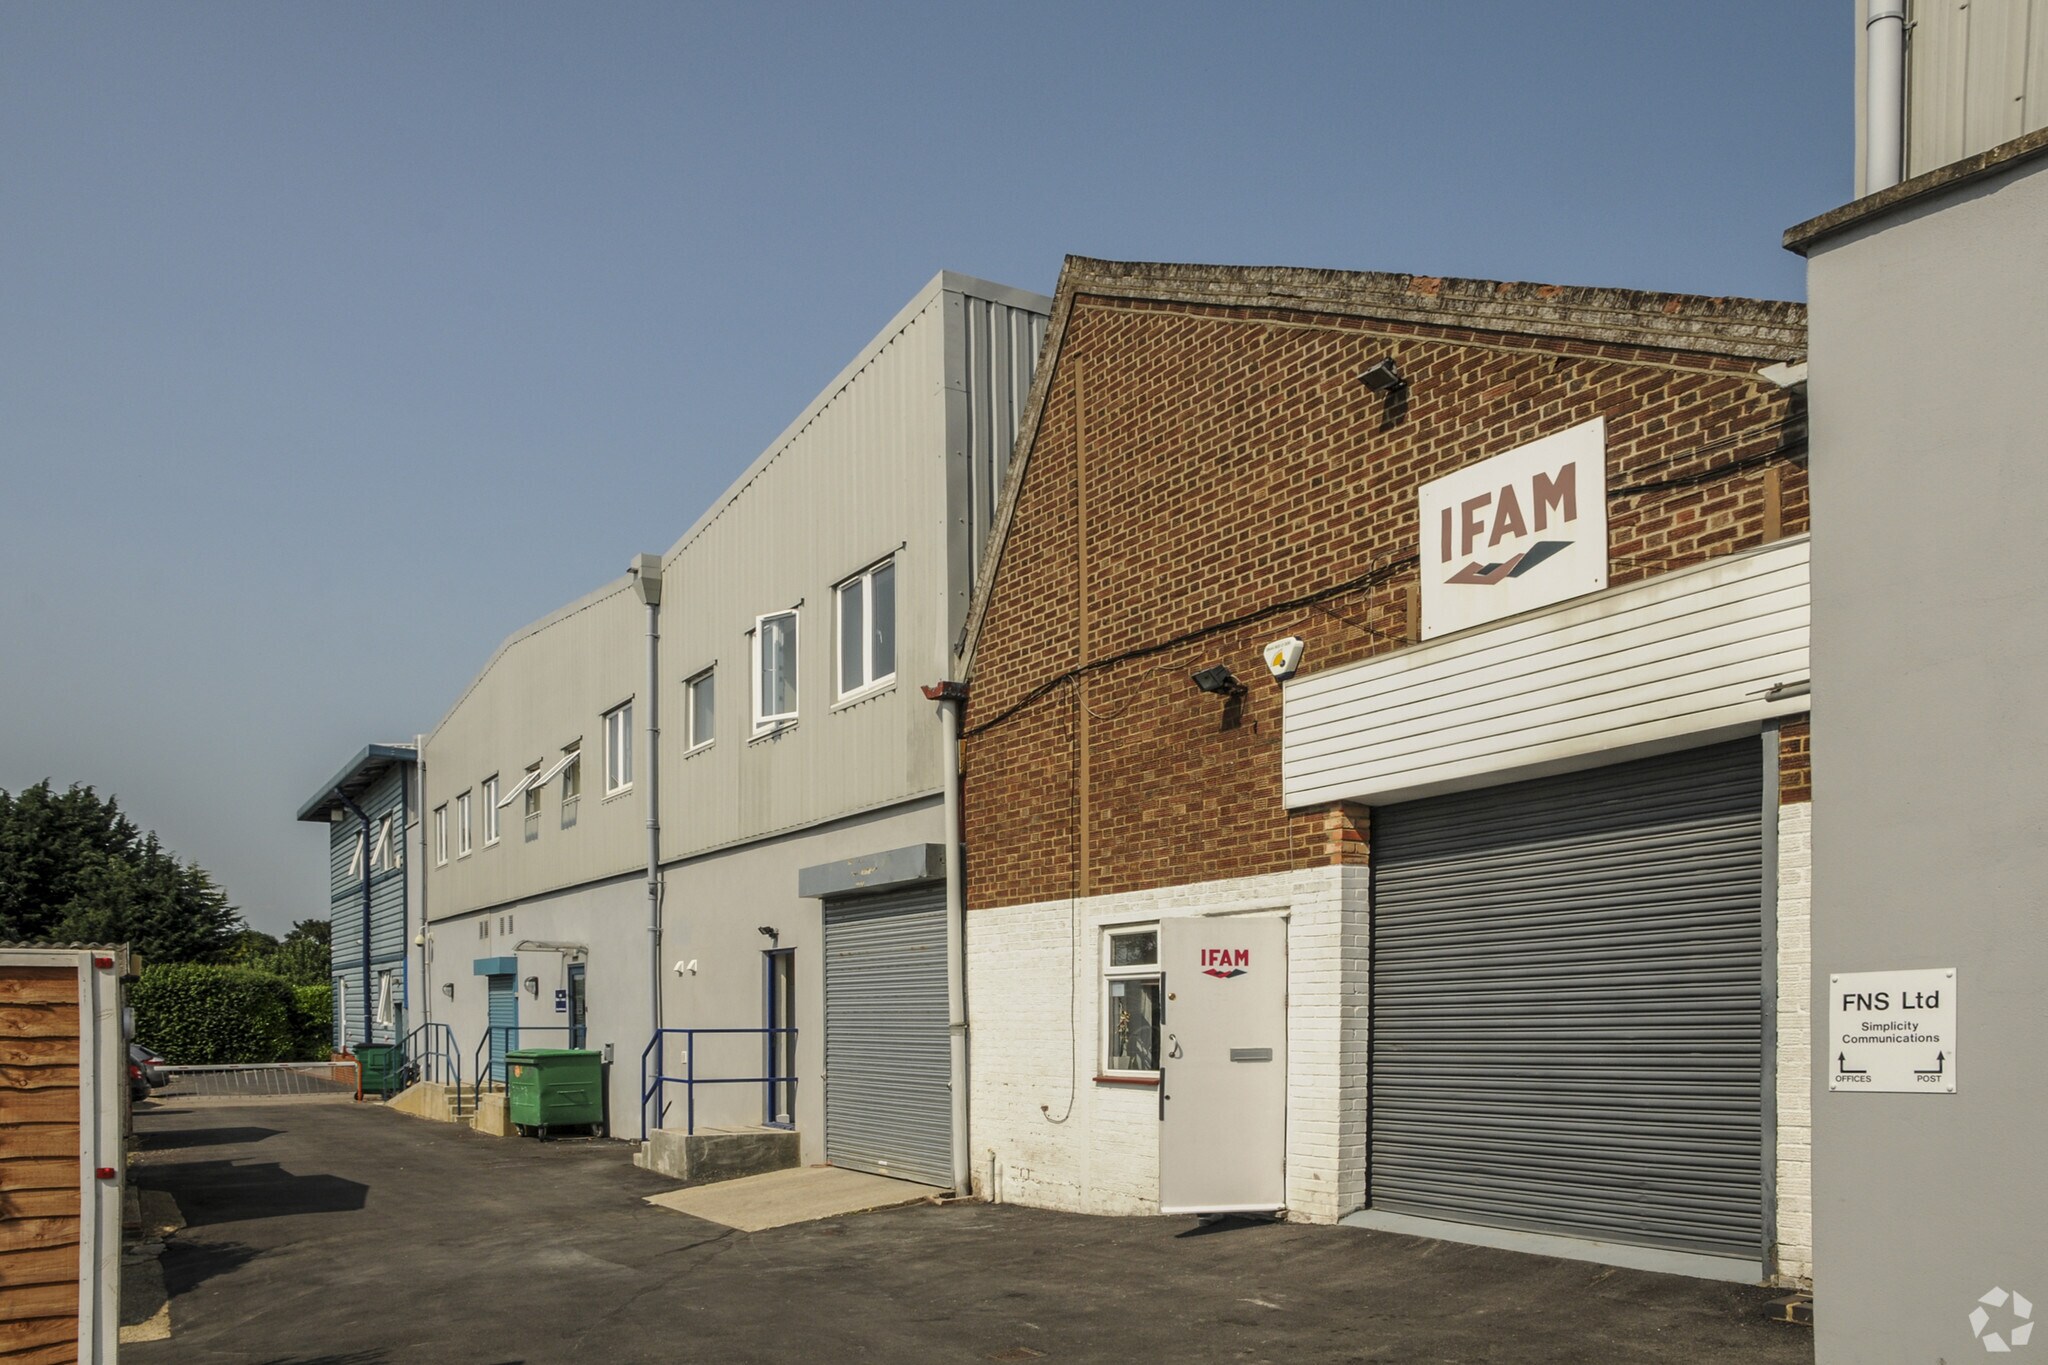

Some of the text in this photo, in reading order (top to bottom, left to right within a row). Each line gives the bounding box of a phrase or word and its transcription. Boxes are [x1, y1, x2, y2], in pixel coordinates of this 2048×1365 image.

[1441, 461, 1577, 563] IFAM
[1201, 949, 1249, 966] IFAM
[1843, 990, 1939, 1011] FNS Ltd
[1861, 1021, 1918, 1031] Simplicity
[1842, 1033, 1940, 1043] Communications
[1835, 1075, 1942, 1083] OFFICES POST
